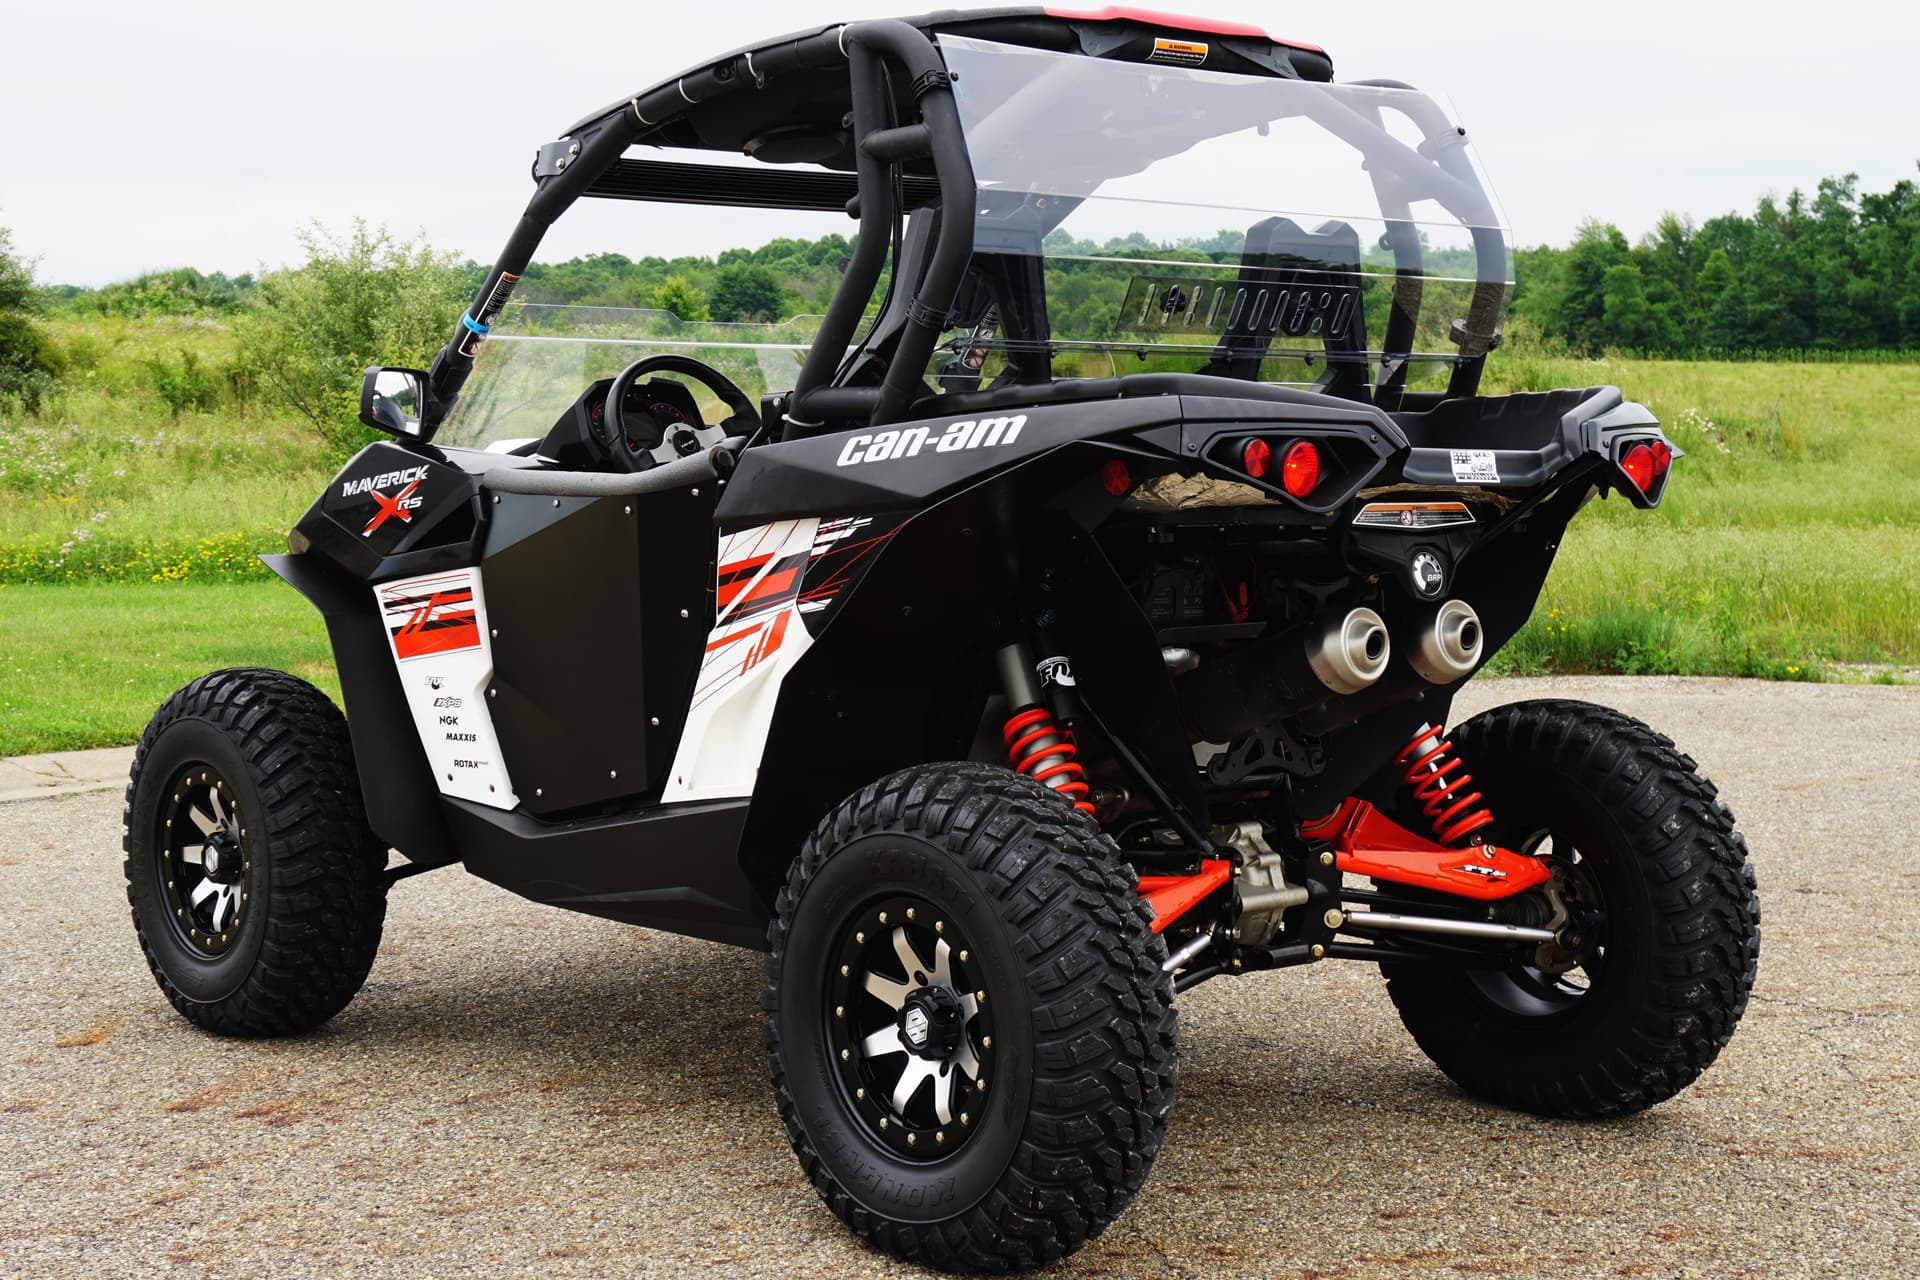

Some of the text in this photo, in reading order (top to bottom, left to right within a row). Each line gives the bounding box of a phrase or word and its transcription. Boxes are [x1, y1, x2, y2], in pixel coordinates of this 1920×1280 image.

[342, 464, 430, 497] MAVERICK
[439, 715, 459, 726] NGK
[445, 732, 477, 742] MAXXIS
[453, 759, 479, 769] ROTAX
